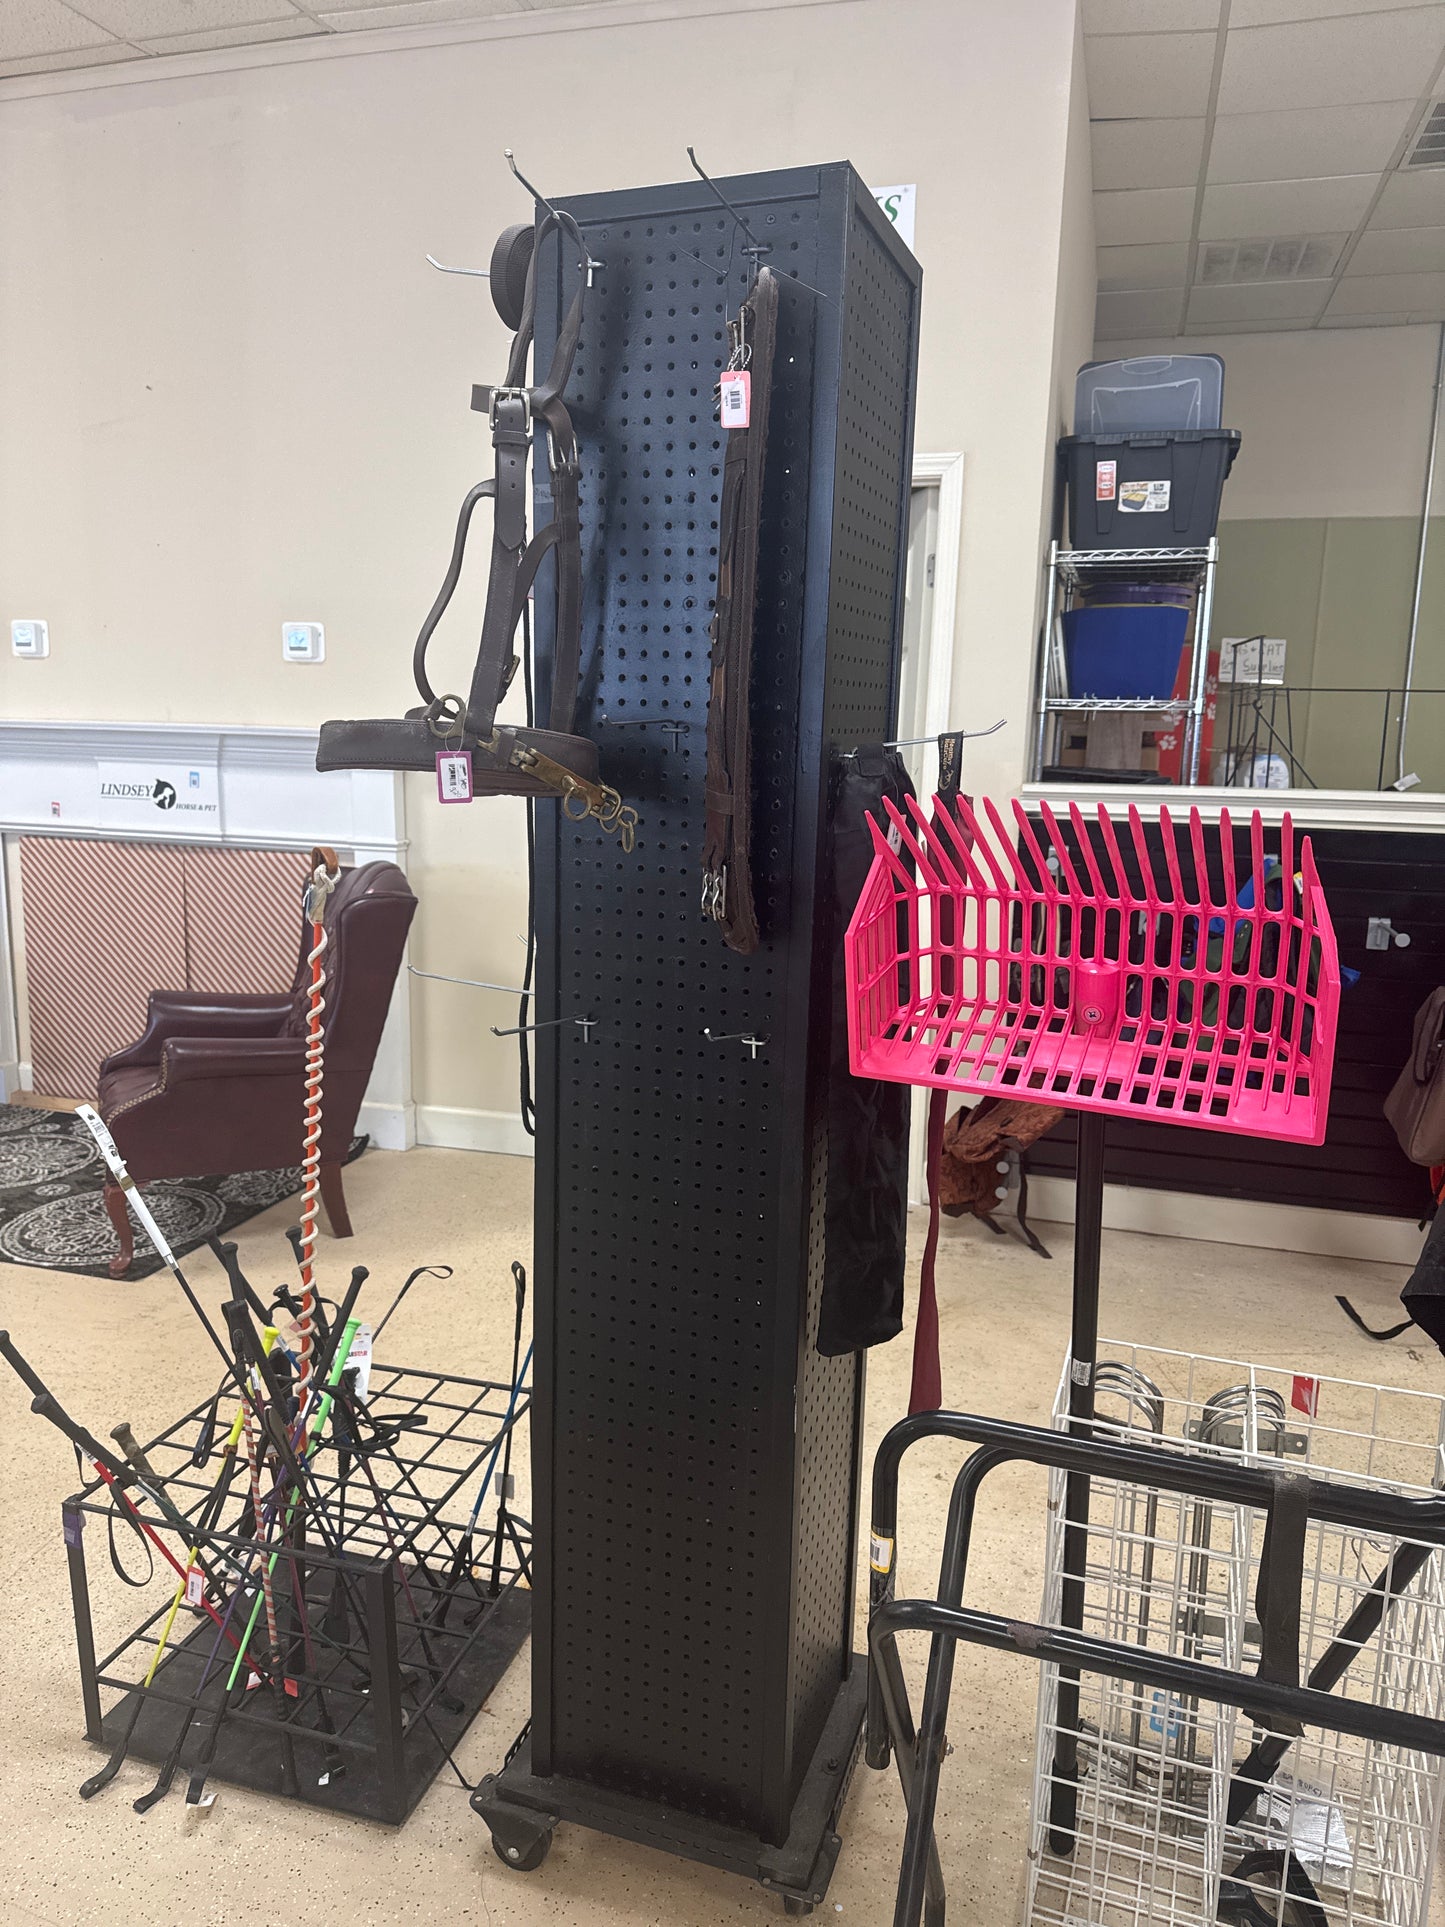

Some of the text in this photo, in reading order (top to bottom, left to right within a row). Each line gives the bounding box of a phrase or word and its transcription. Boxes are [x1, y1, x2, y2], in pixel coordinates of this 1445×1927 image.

[100, 783, 154, 797] LINDSEY
[175, 803, 197, 811] HORSE
[204, 804, 218, 812] PET
